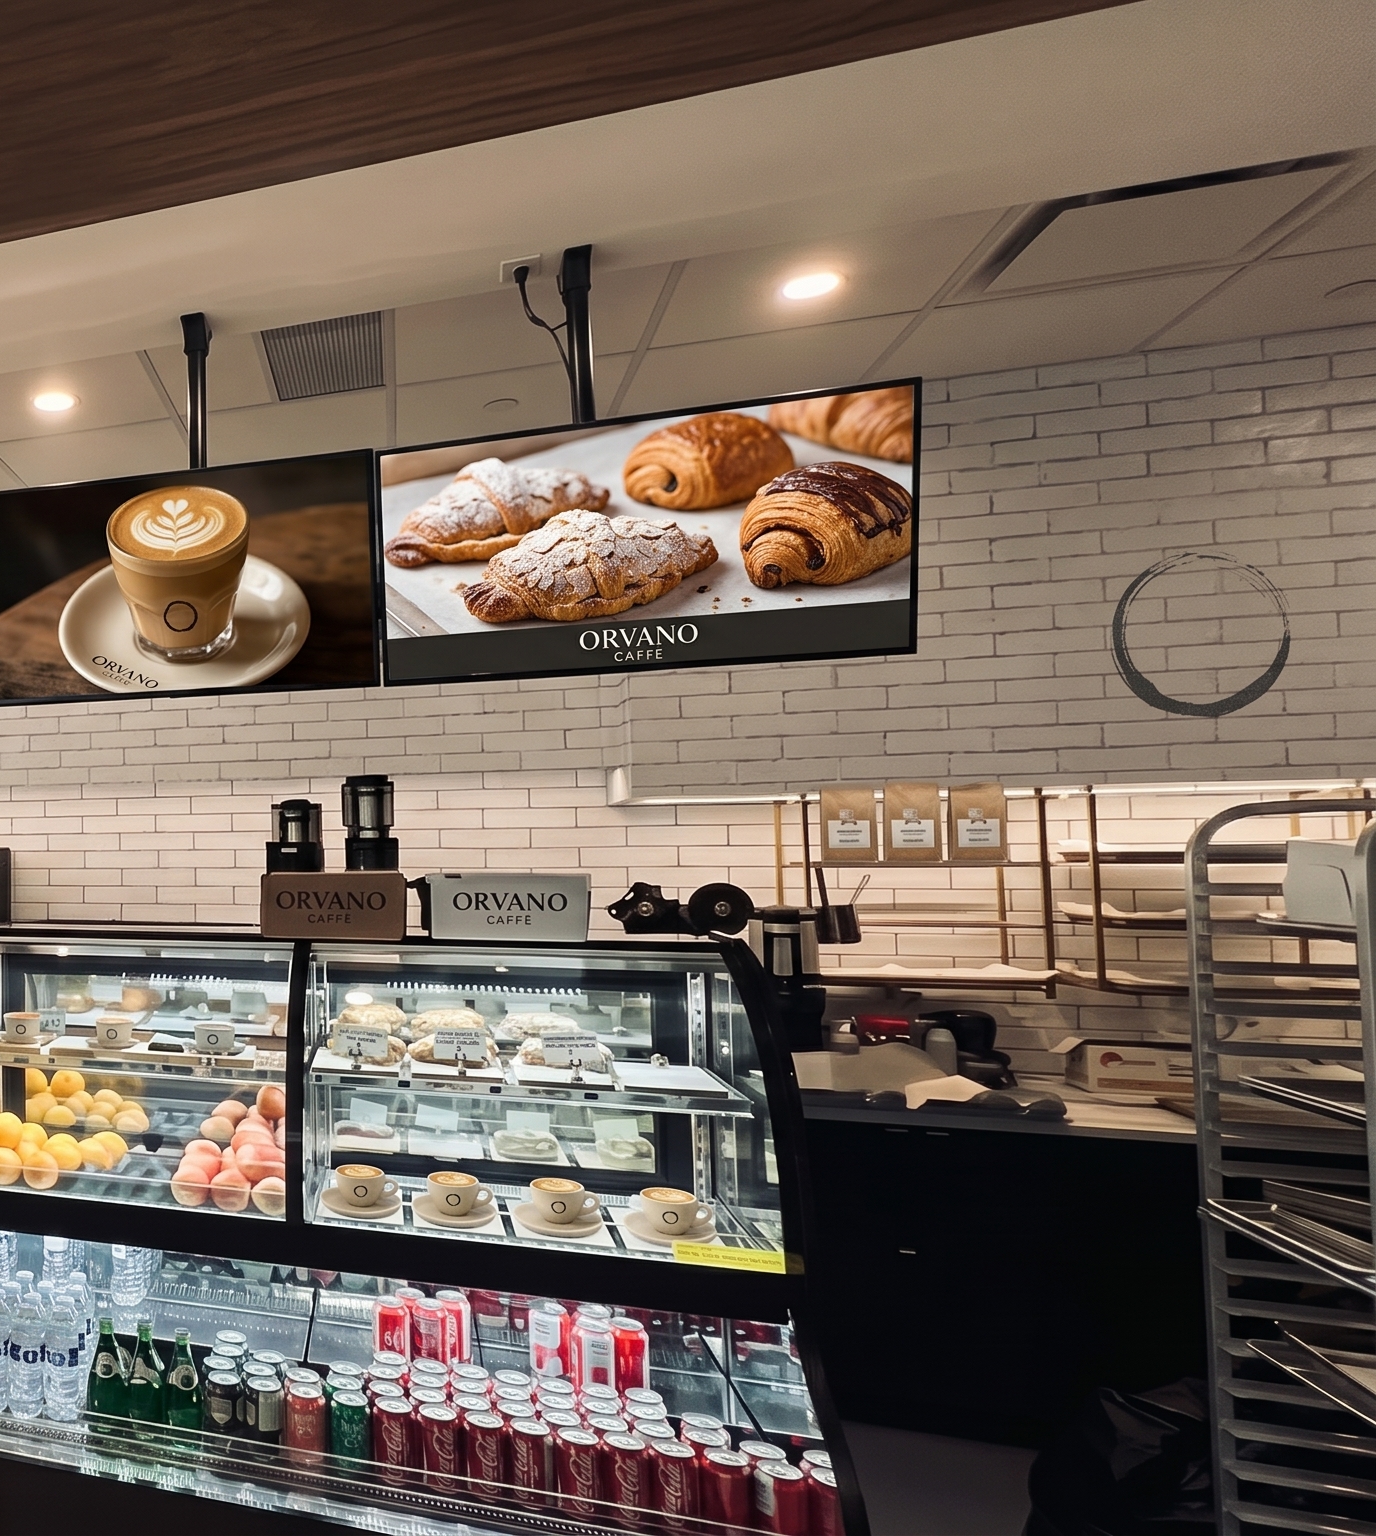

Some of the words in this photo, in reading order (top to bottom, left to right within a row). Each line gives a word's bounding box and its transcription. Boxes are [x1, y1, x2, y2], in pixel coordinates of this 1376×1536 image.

[579, 623, 699, 651] ORVANO
[91, 655, 159, 689] ORVANO
[275, 890, 387, 911] ORVANO
[452, 891, 568, 912] ORVANO
